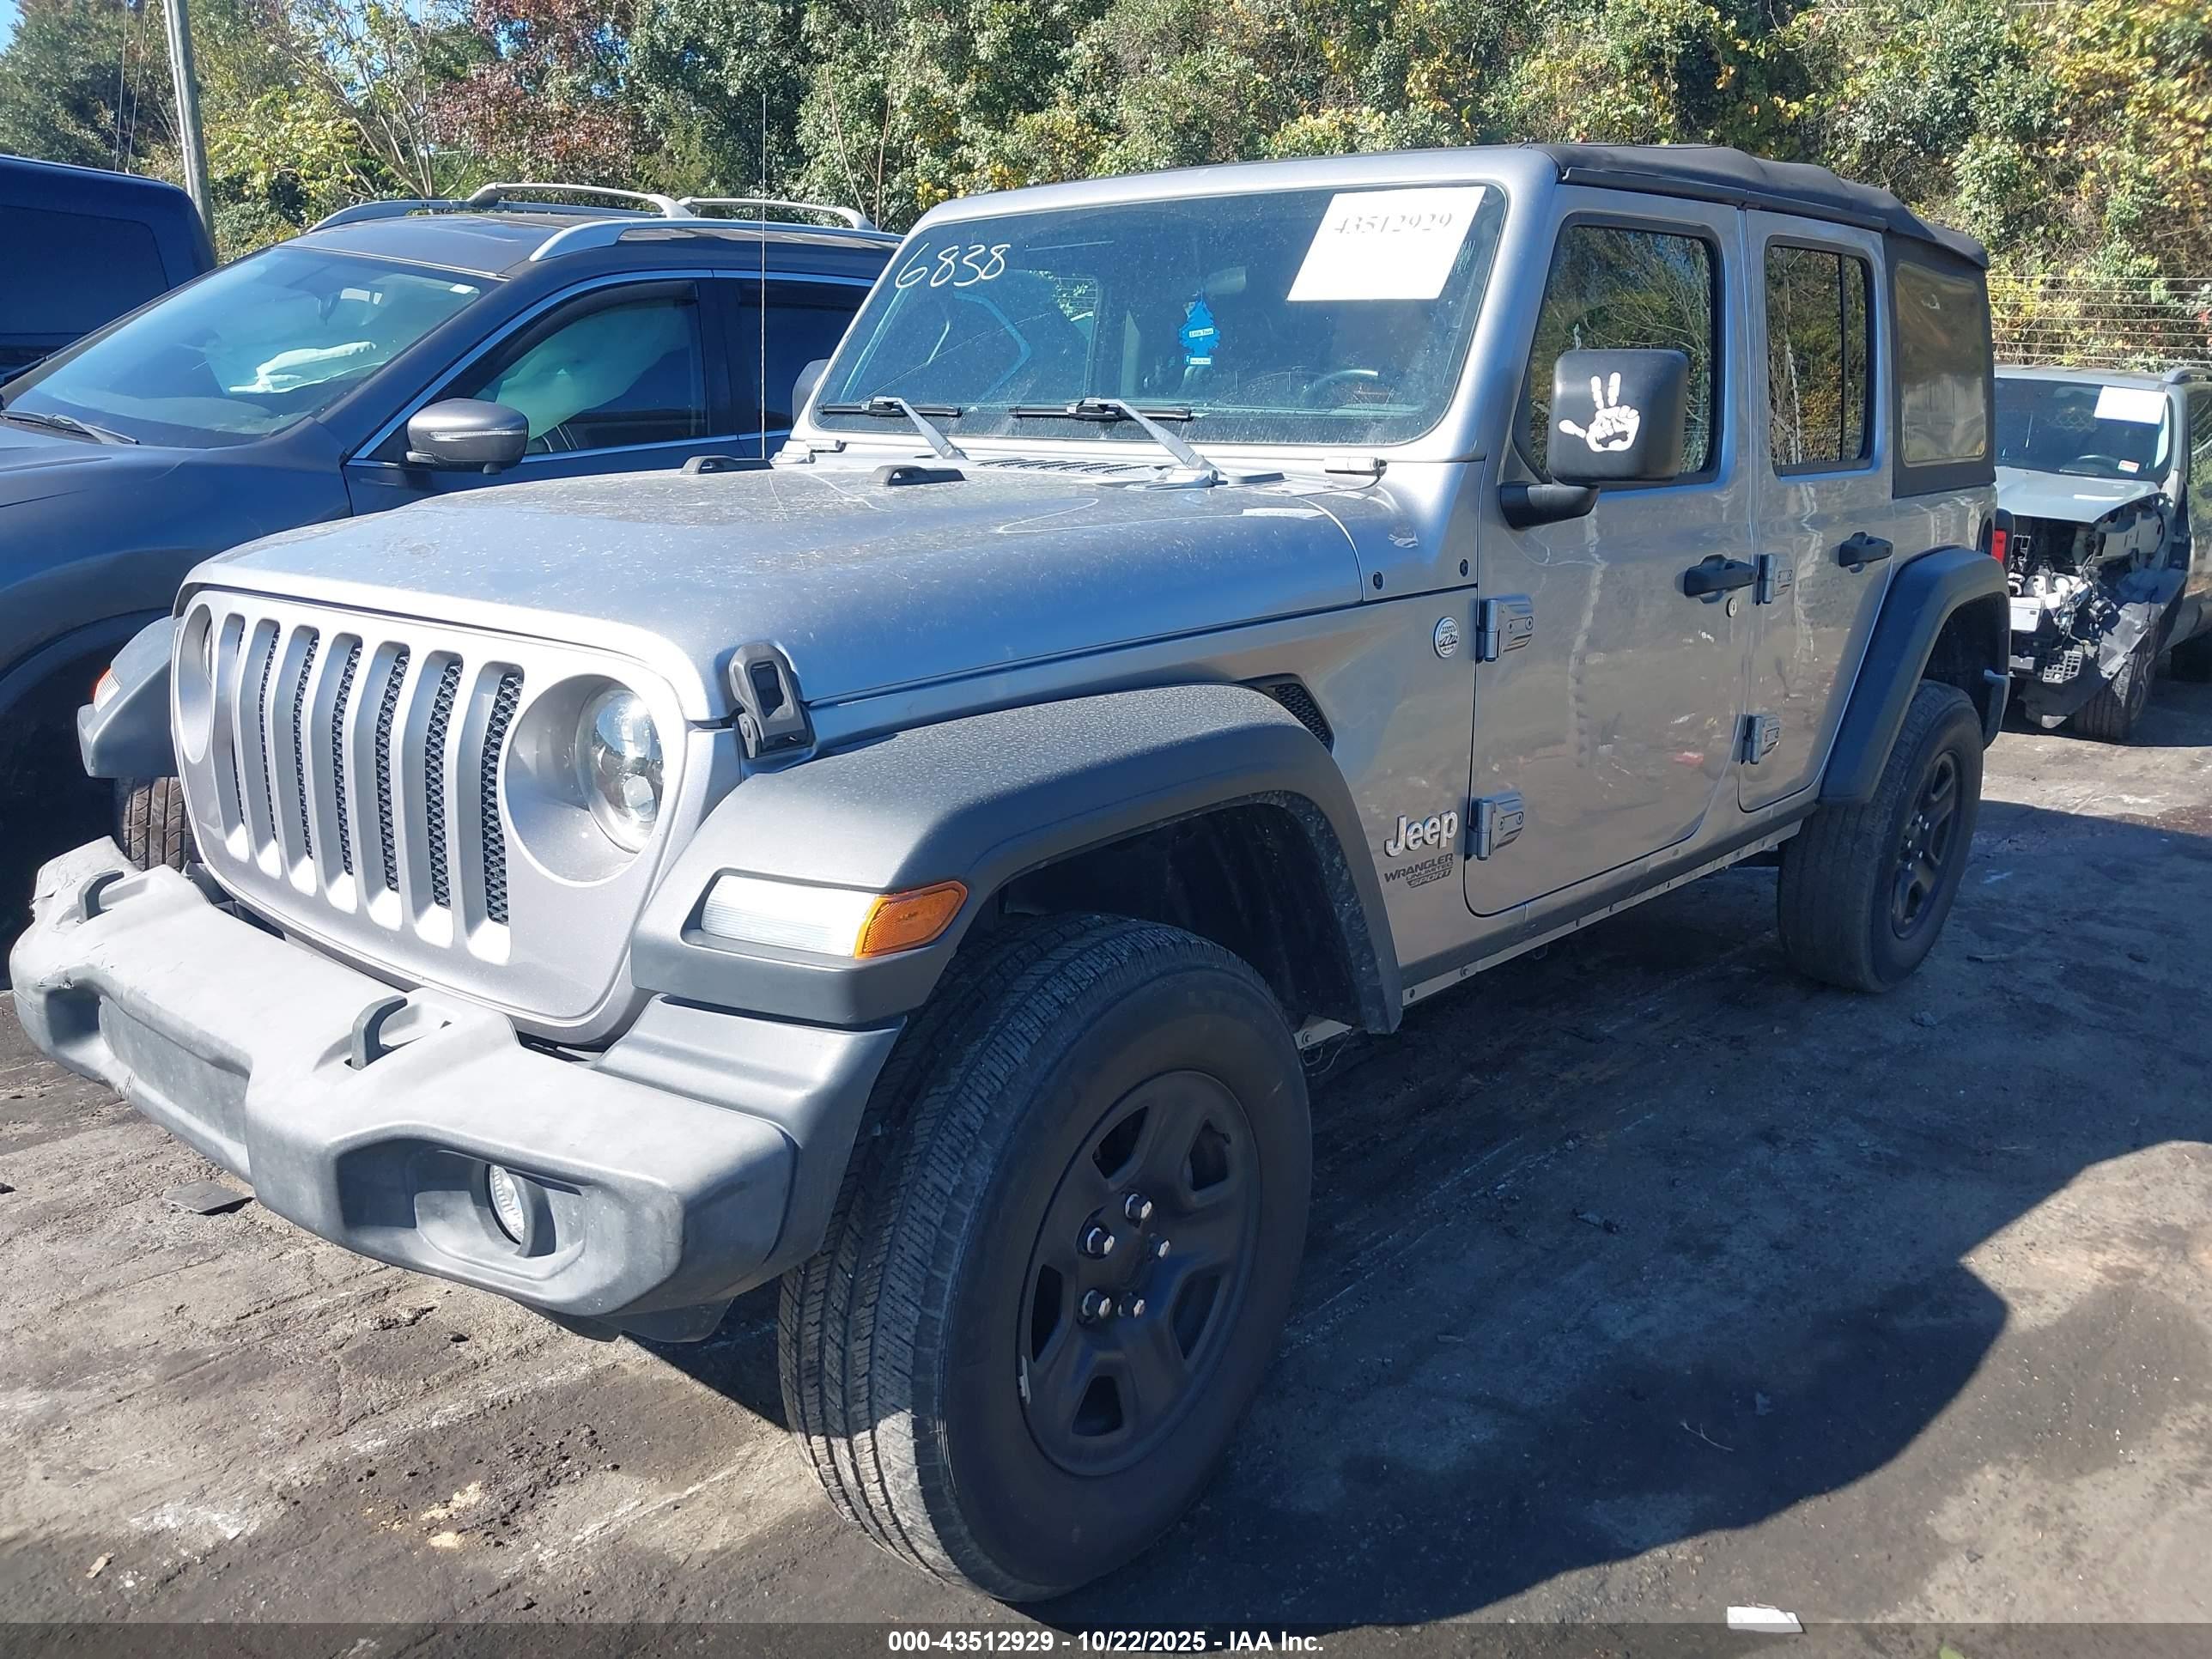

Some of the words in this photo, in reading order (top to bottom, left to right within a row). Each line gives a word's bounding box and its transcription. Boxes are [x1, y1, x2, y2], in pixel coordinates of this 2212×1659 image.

[1334, 213, 1453, 234] 43512929
[895, 242, 1012, 289] 6838
[1384, 810, 1458, 858] Jeep
[1383, 853, 1454, 883] WRANGLER
[1406, 861, 1454, 881] UNLIMITED
